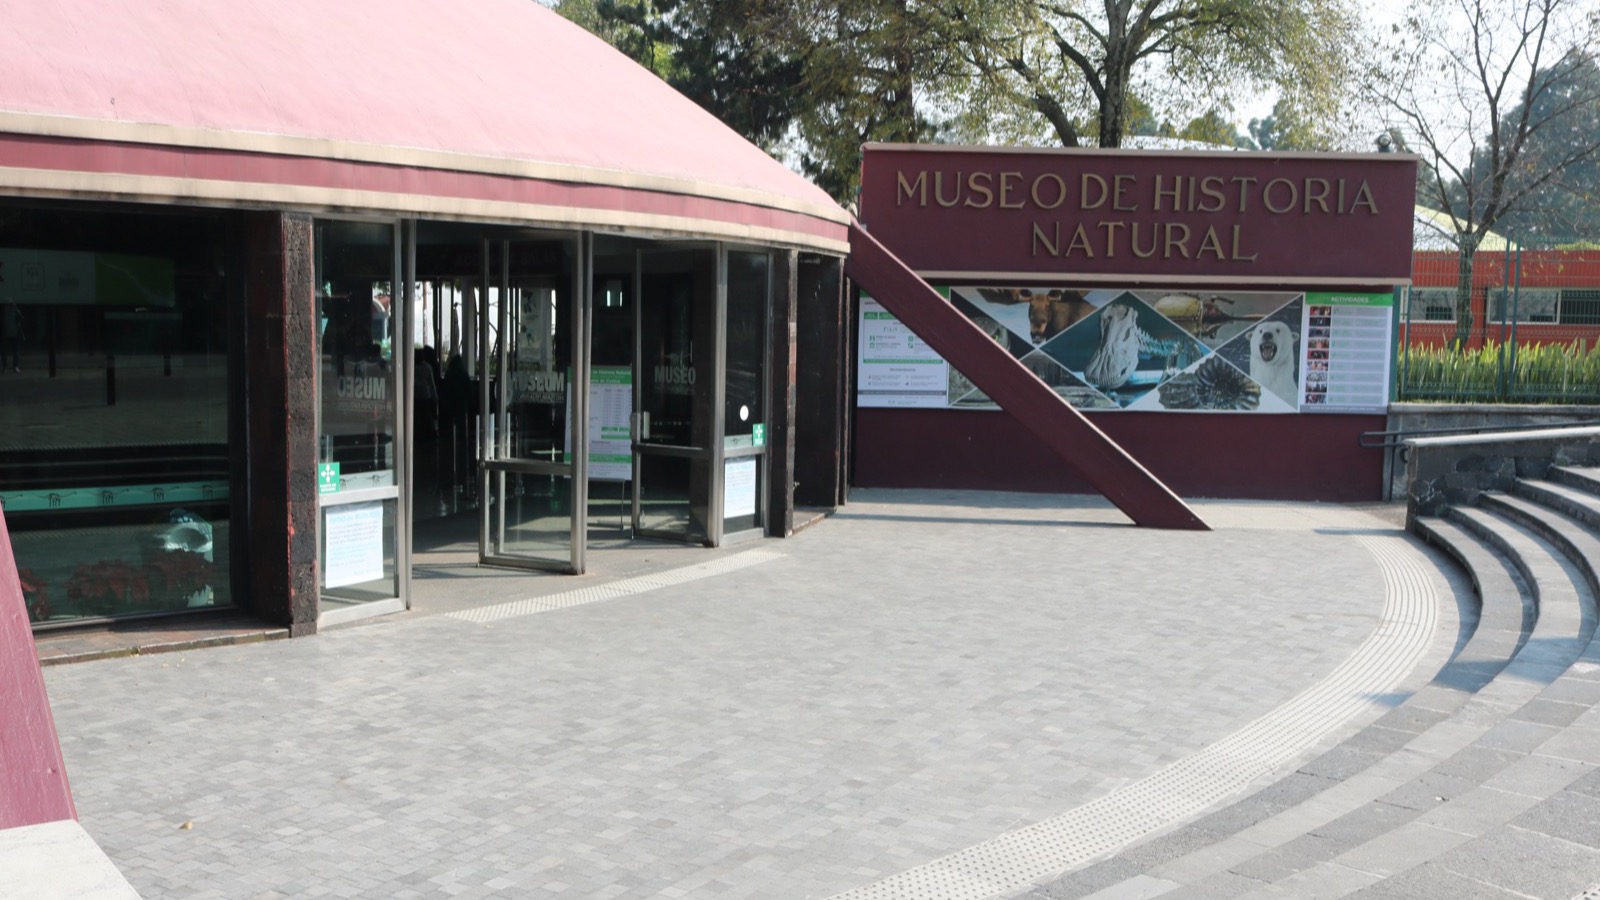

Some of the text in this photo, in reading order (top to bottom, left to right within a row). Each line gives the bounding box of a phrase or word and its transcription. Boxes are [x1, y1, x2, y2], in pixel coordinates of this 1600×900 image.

[896, 169, 1380, 216] MUSEO DE HISTORIA
[1031, 220, 1260, 262] NATURAL
[655, 366, 696, 384] MUSEO
